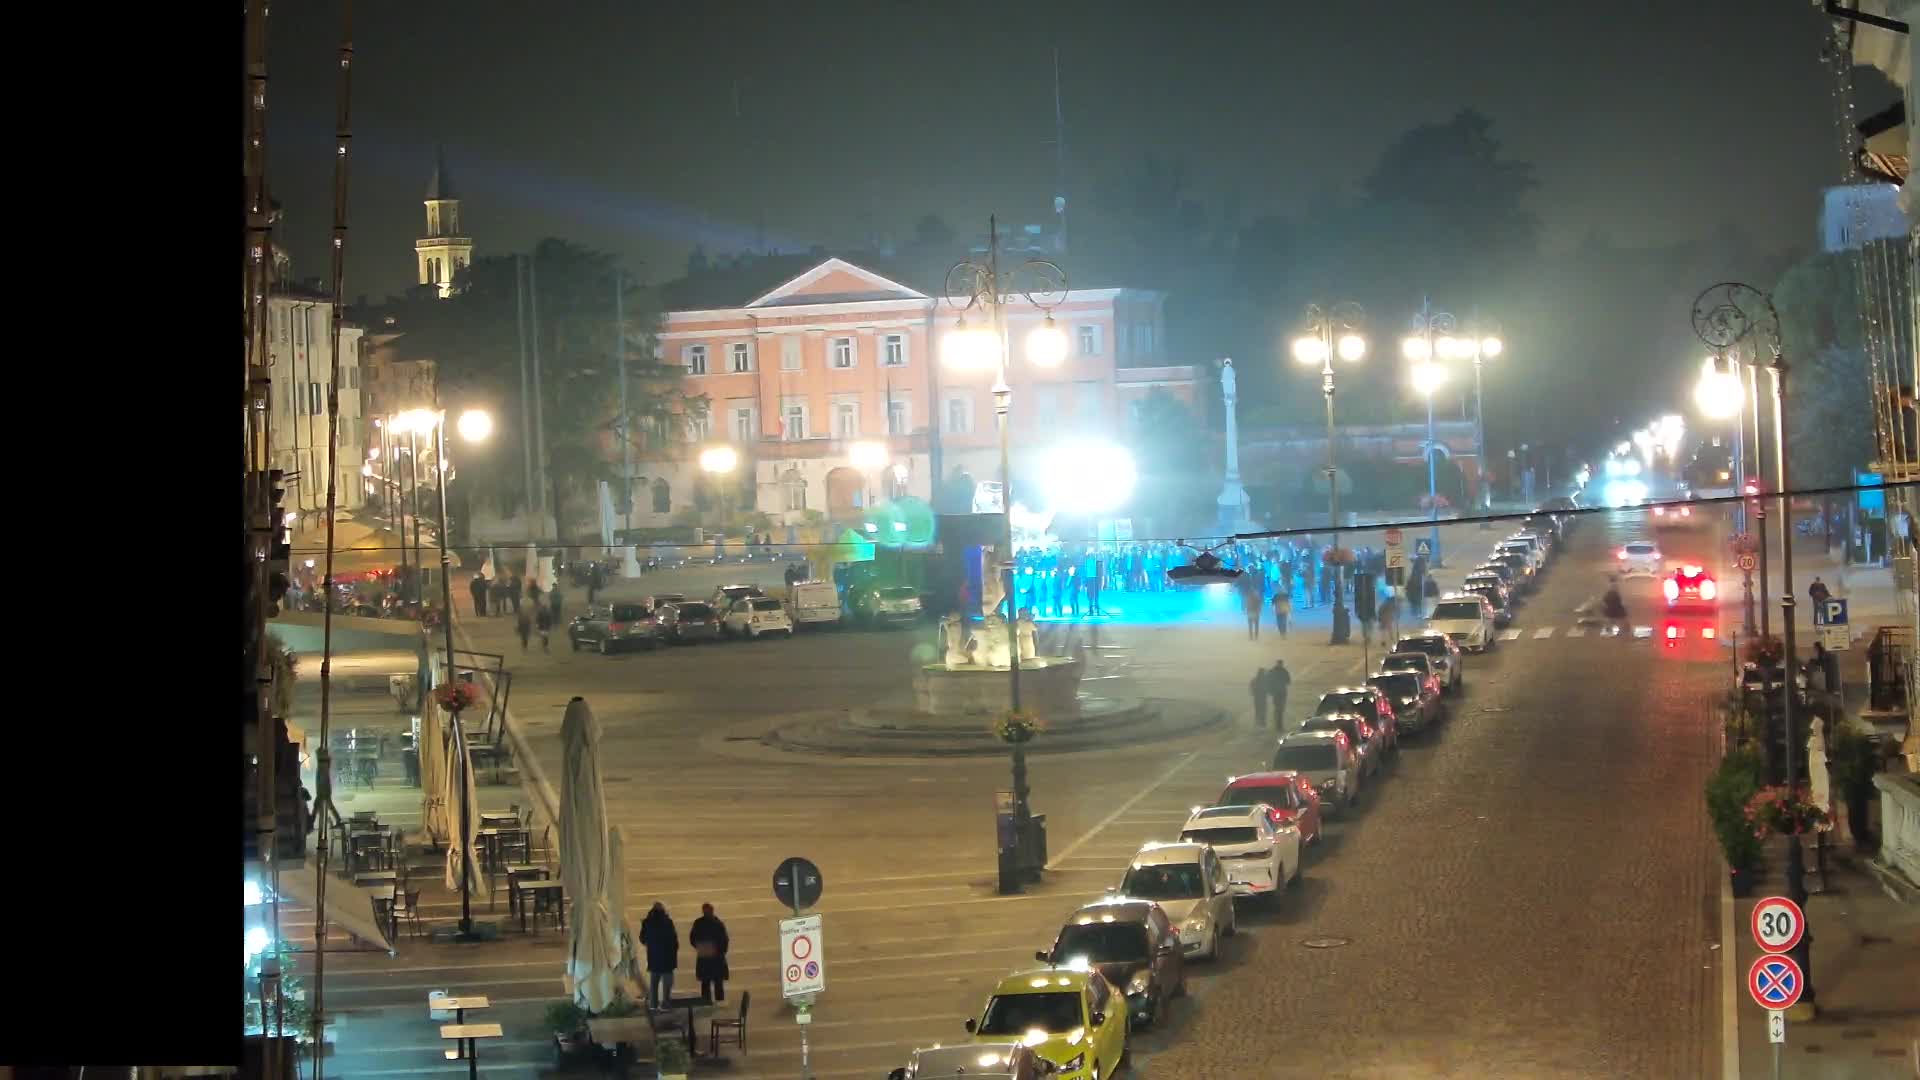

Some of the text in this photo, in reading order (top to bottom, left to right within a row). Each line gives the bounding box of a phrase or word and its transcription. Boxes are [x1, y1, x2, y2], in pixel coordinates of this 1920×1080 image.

[1828, 602, 1842, 622] P
[1762, 912, 1791, 937] 30
[790, 968, 798, 978] 20
